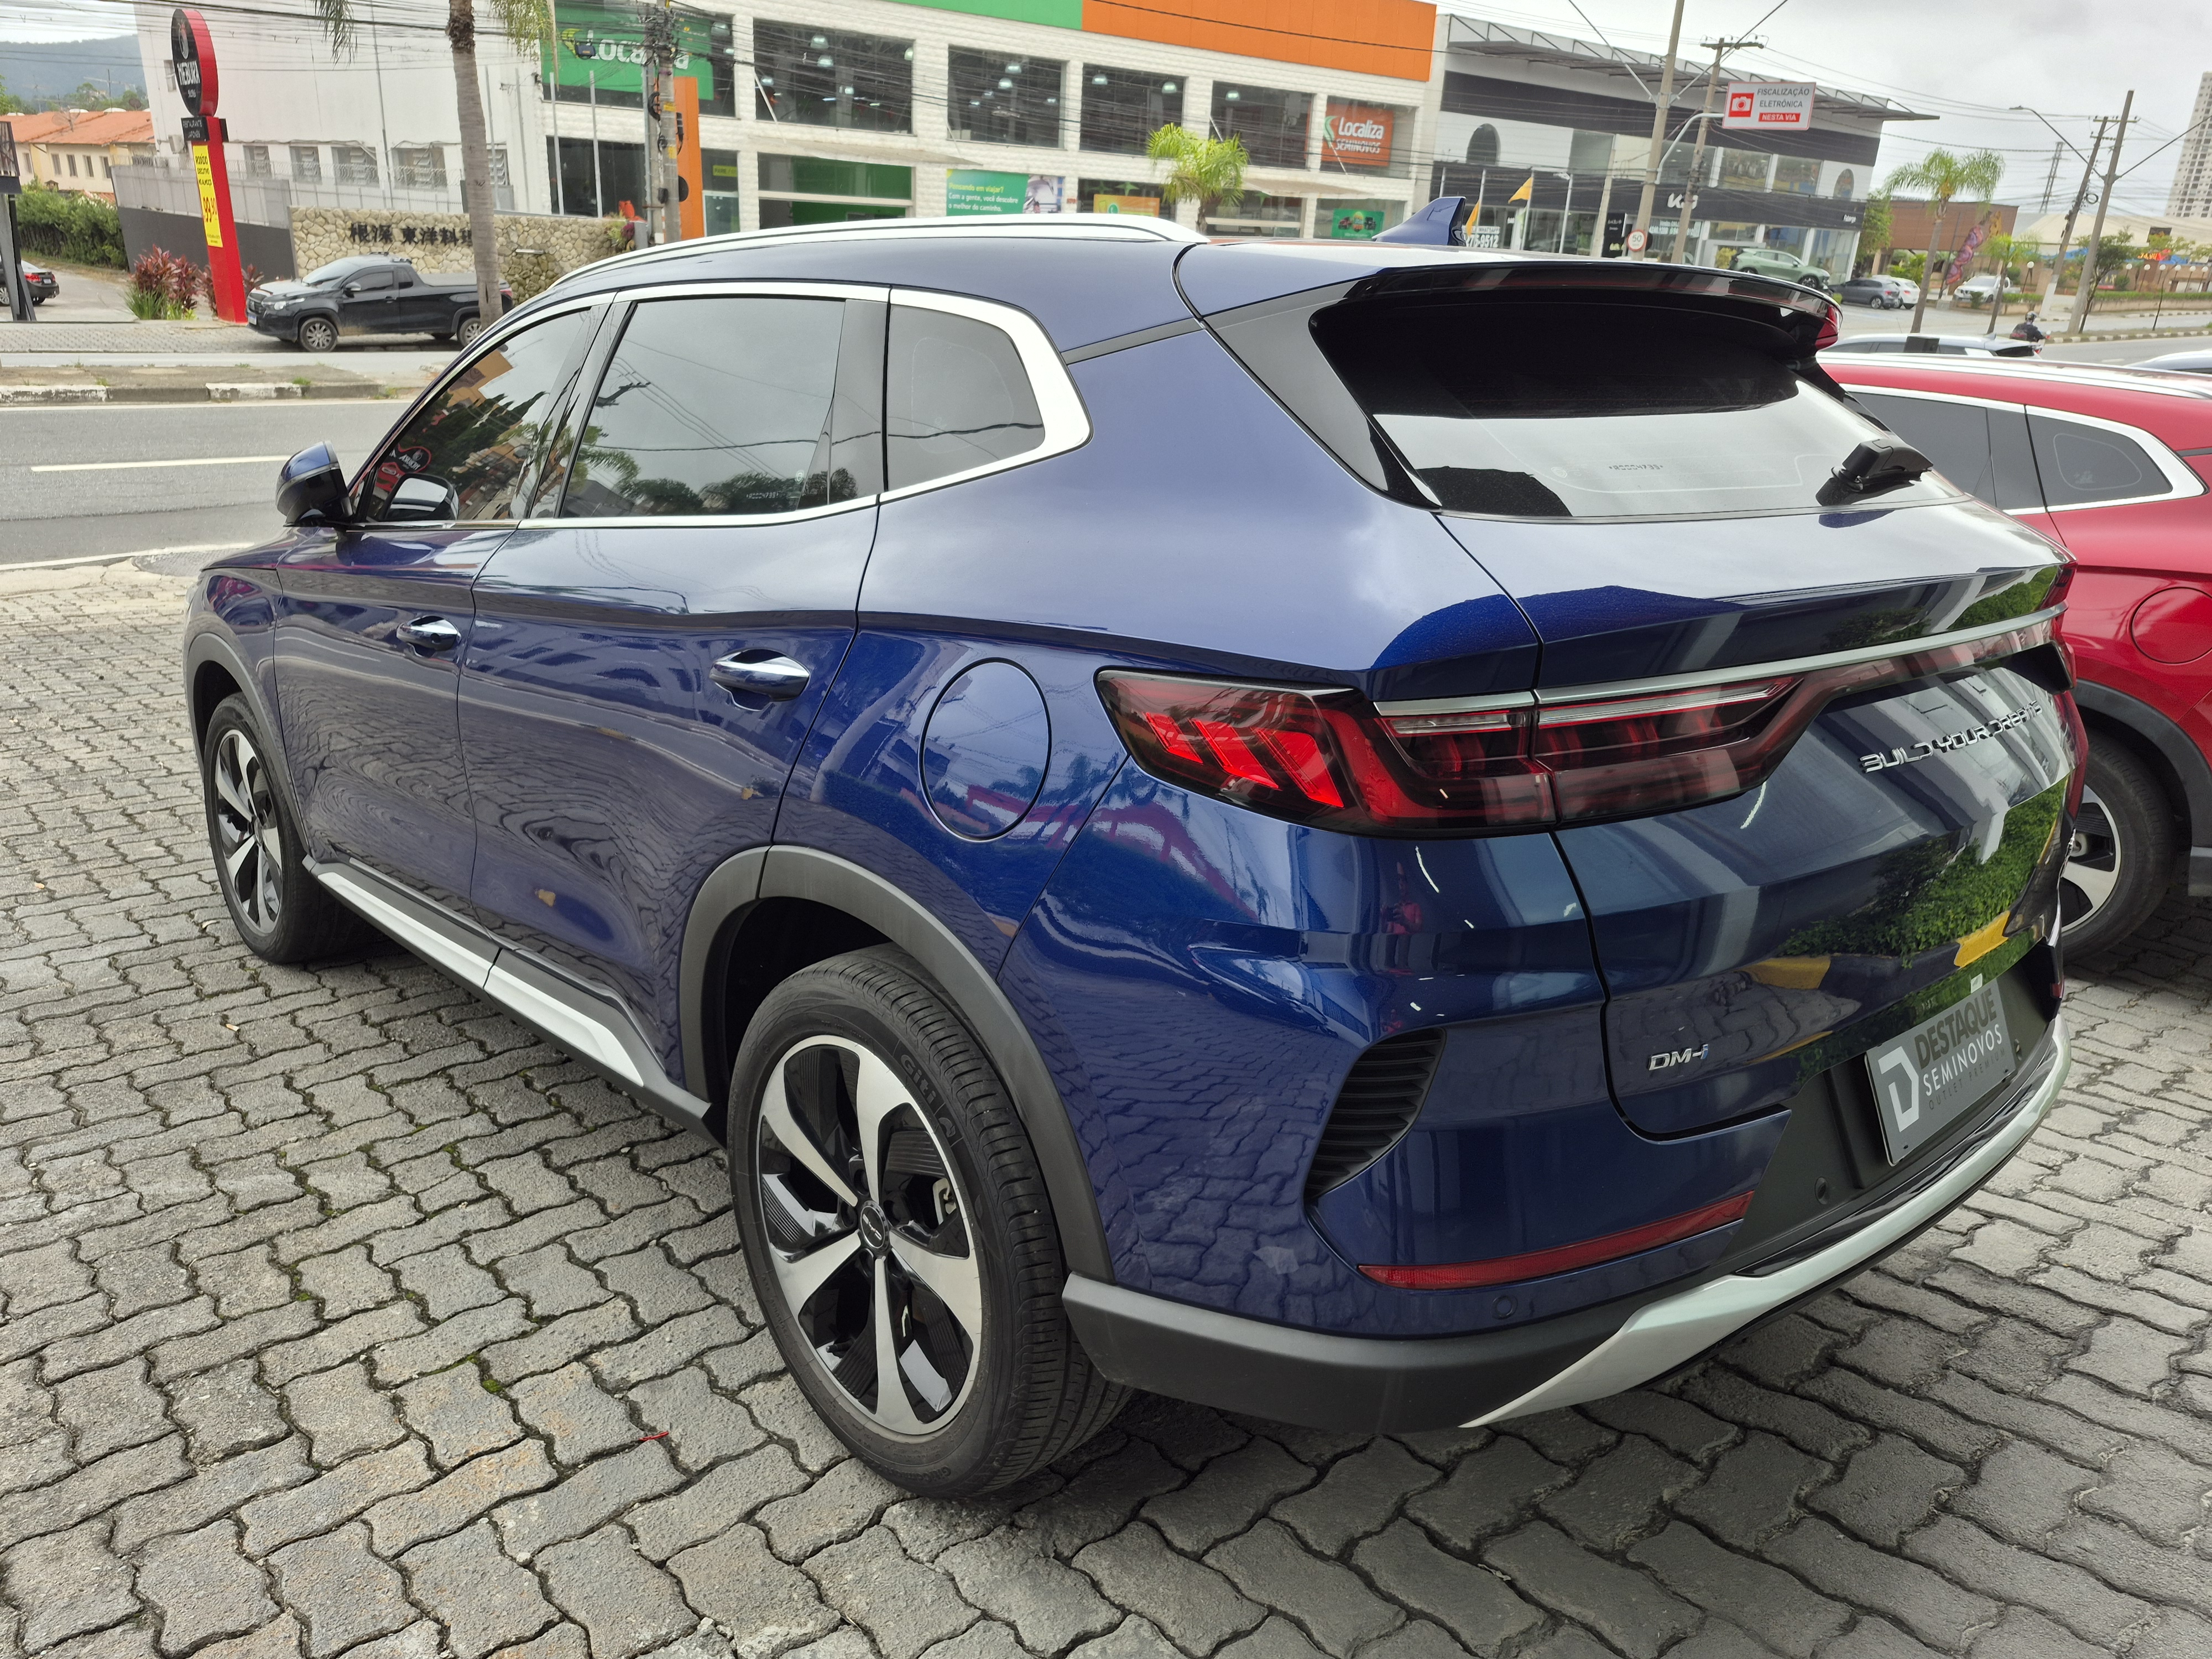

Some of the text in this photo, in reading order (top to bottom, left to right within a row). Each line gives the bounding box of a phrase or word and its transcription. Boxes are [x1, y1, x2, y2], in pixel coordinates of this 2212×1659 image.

[585, 29, 690, 70] Locaa
[1757, 87, 1810, 97] FISCALIZAÇÃO
[1759, 98, 1803, 108] ELETRÔNICA
[1338, 117, 1384, 139] Localiza
[1334, 138, 1381, 154] SEMINOVOS
[948, 182, 975, 191] Pensando
[1632, 234, 1642, 242] 50
[1914, 988, 1997, 1070] DESTAQUE
[1648, 1044, 1708, 1071] DM-i
[1923, 1024, 2002, 1097] SEMINOVOS
[900, 1054, 936, 1104] Giti
[1928, 1048, 2005, 1110] OUTLET PREMIUM
